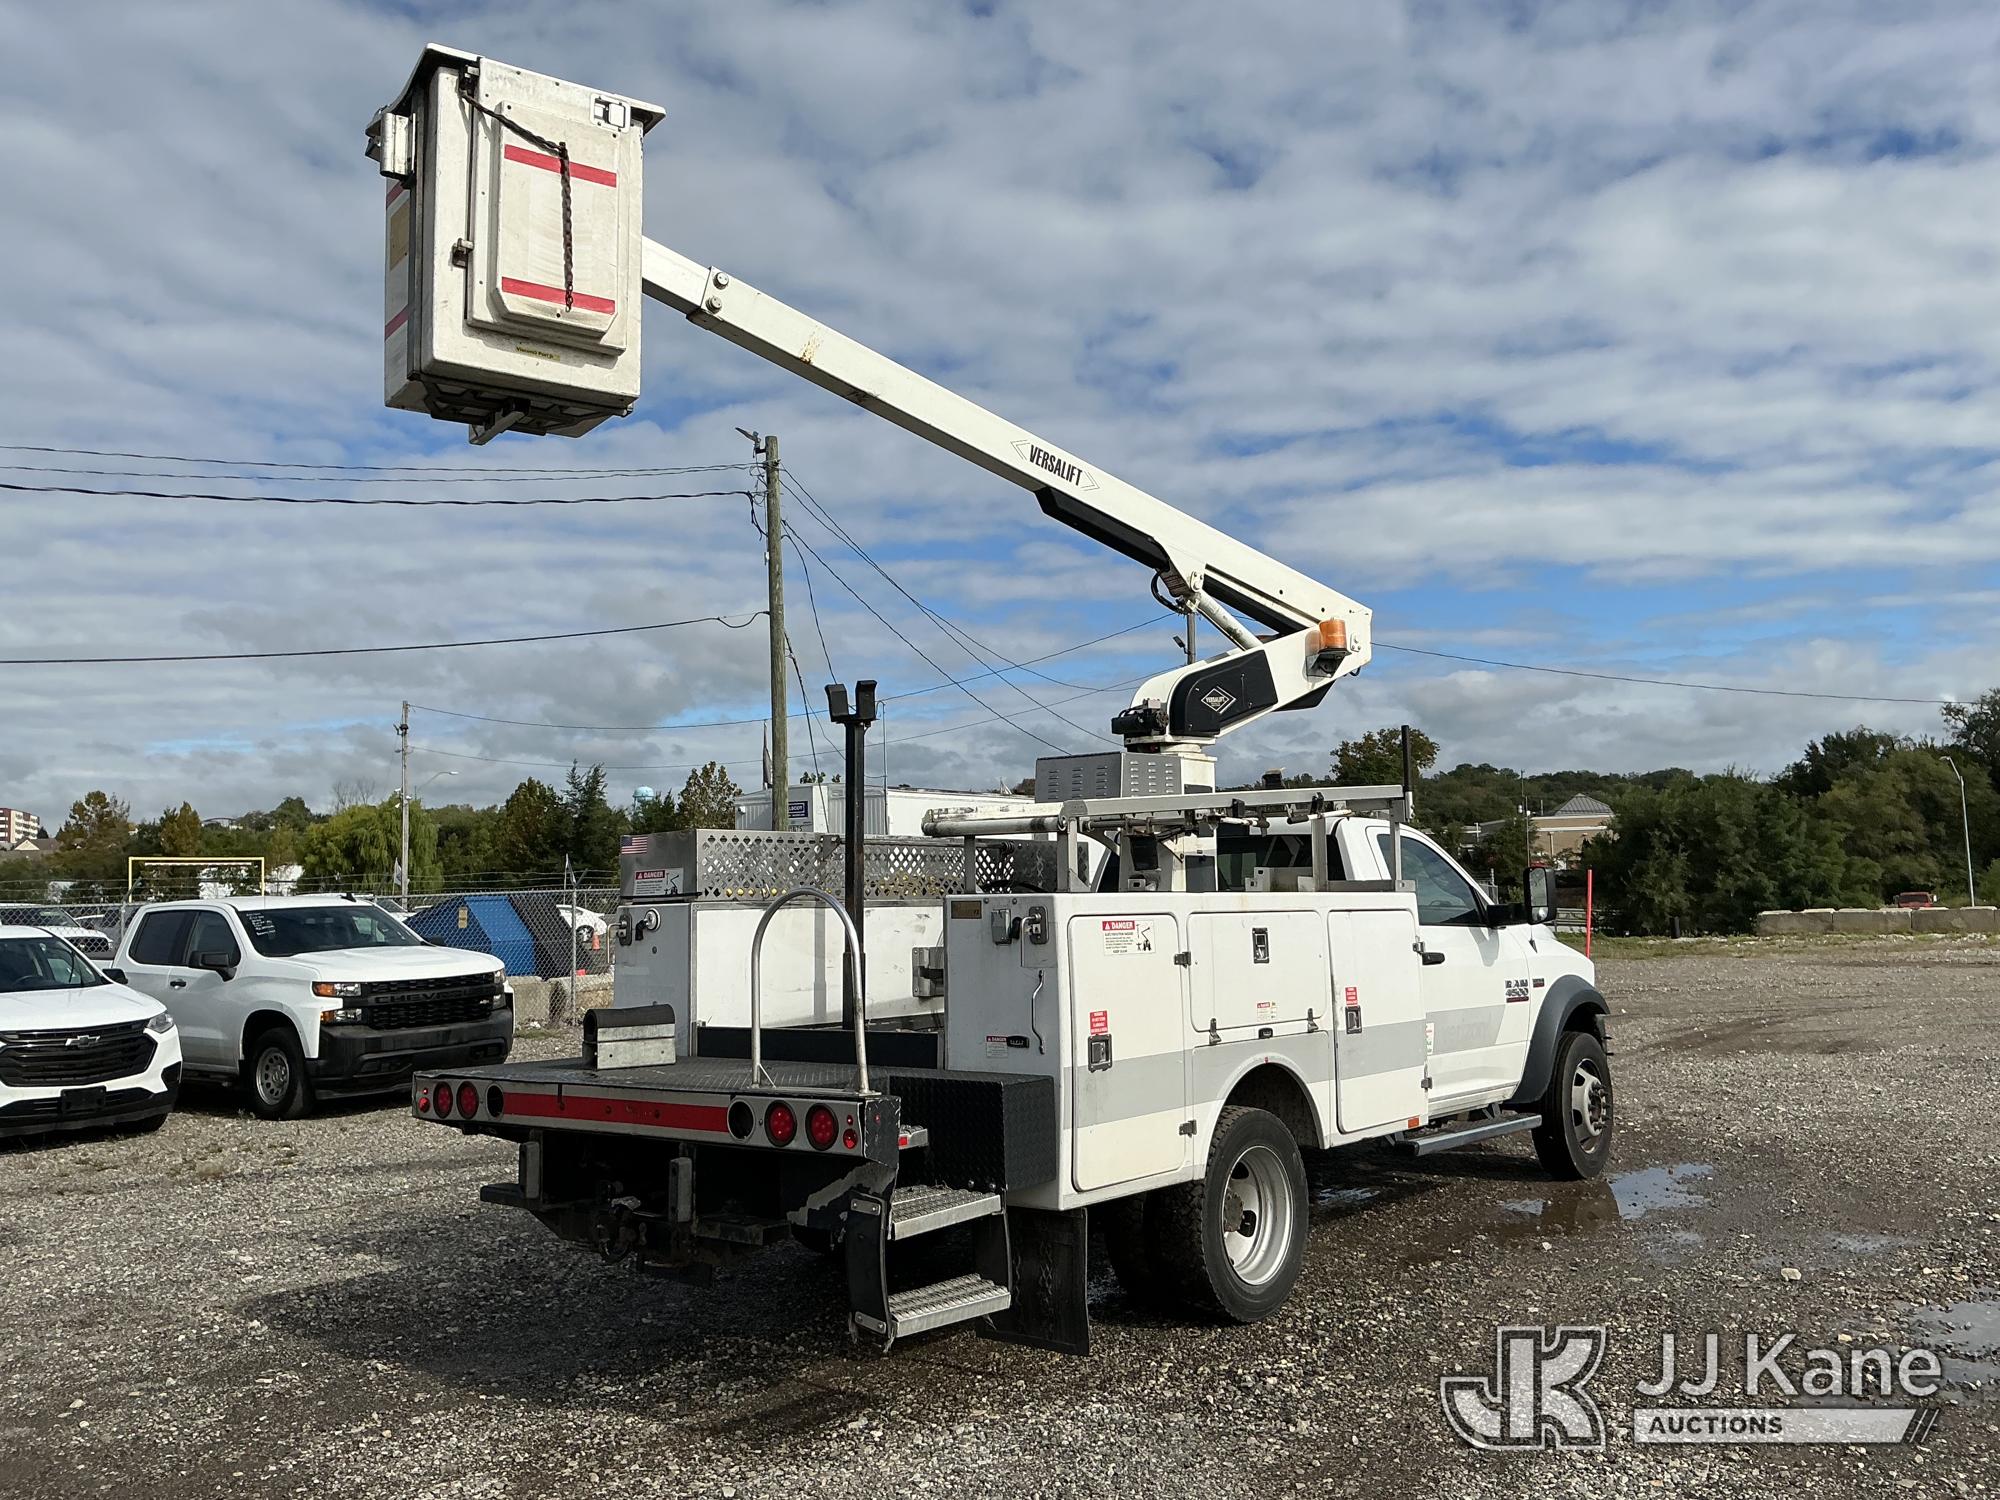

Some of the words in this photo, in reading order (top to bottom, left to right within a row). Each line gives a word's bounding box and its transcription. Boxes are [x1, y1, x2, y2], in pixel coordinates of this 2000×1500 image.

[1029, 444, 1082, 486] VERSALIFT
[1111, 921, 1134, 930] DANGER
[1505, 979, 1528, 988] RAM
